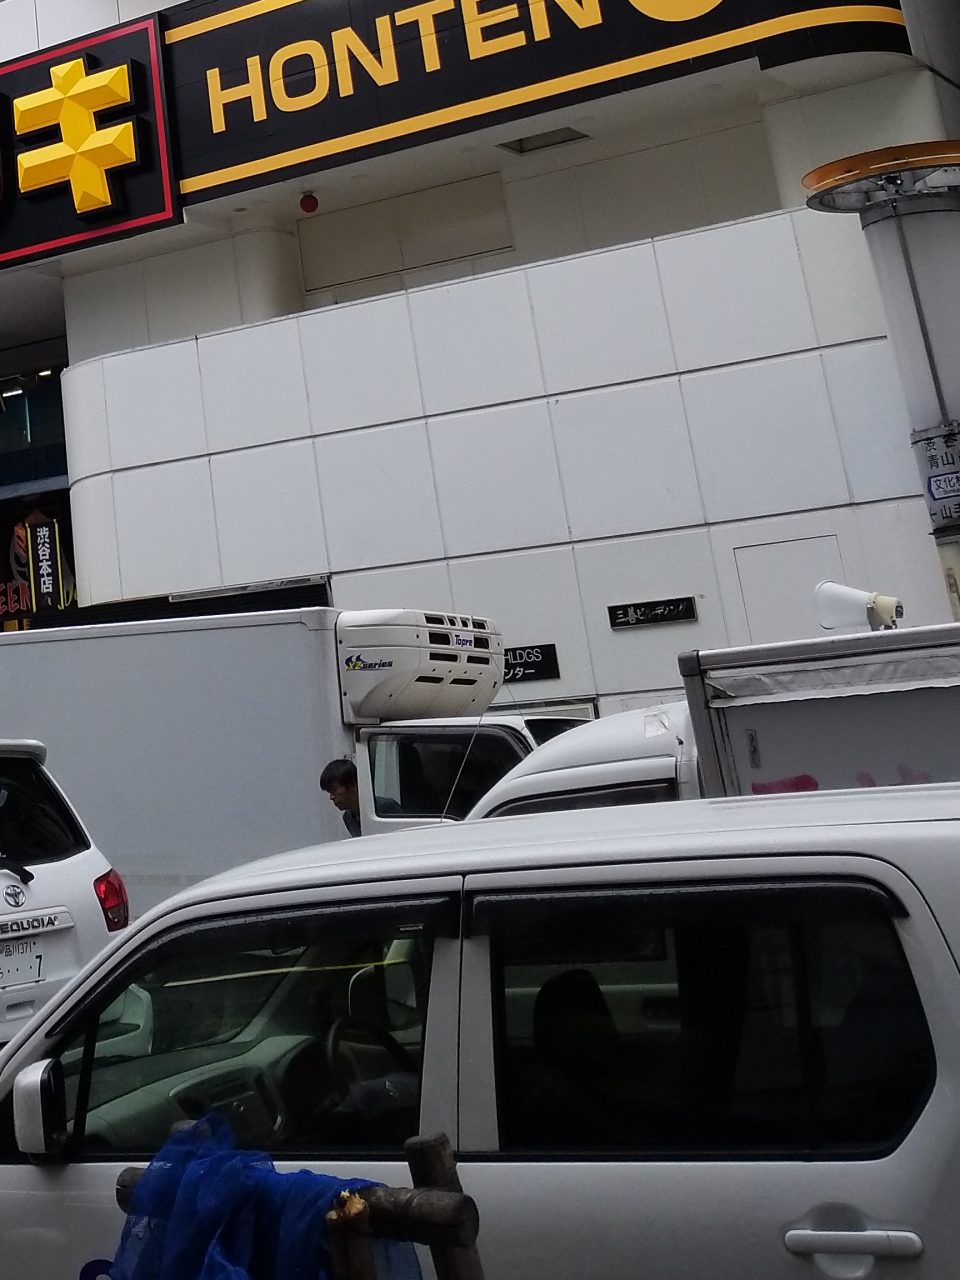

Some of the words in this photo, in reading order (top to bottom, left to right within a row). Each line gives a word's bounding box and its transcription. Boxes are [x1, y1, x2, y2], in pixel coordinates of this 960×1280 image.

[928, 452, 960, 469] 青山
[36, 526, 53, 593] 渋谷本店
[454, 634, 473, 647] Topre
